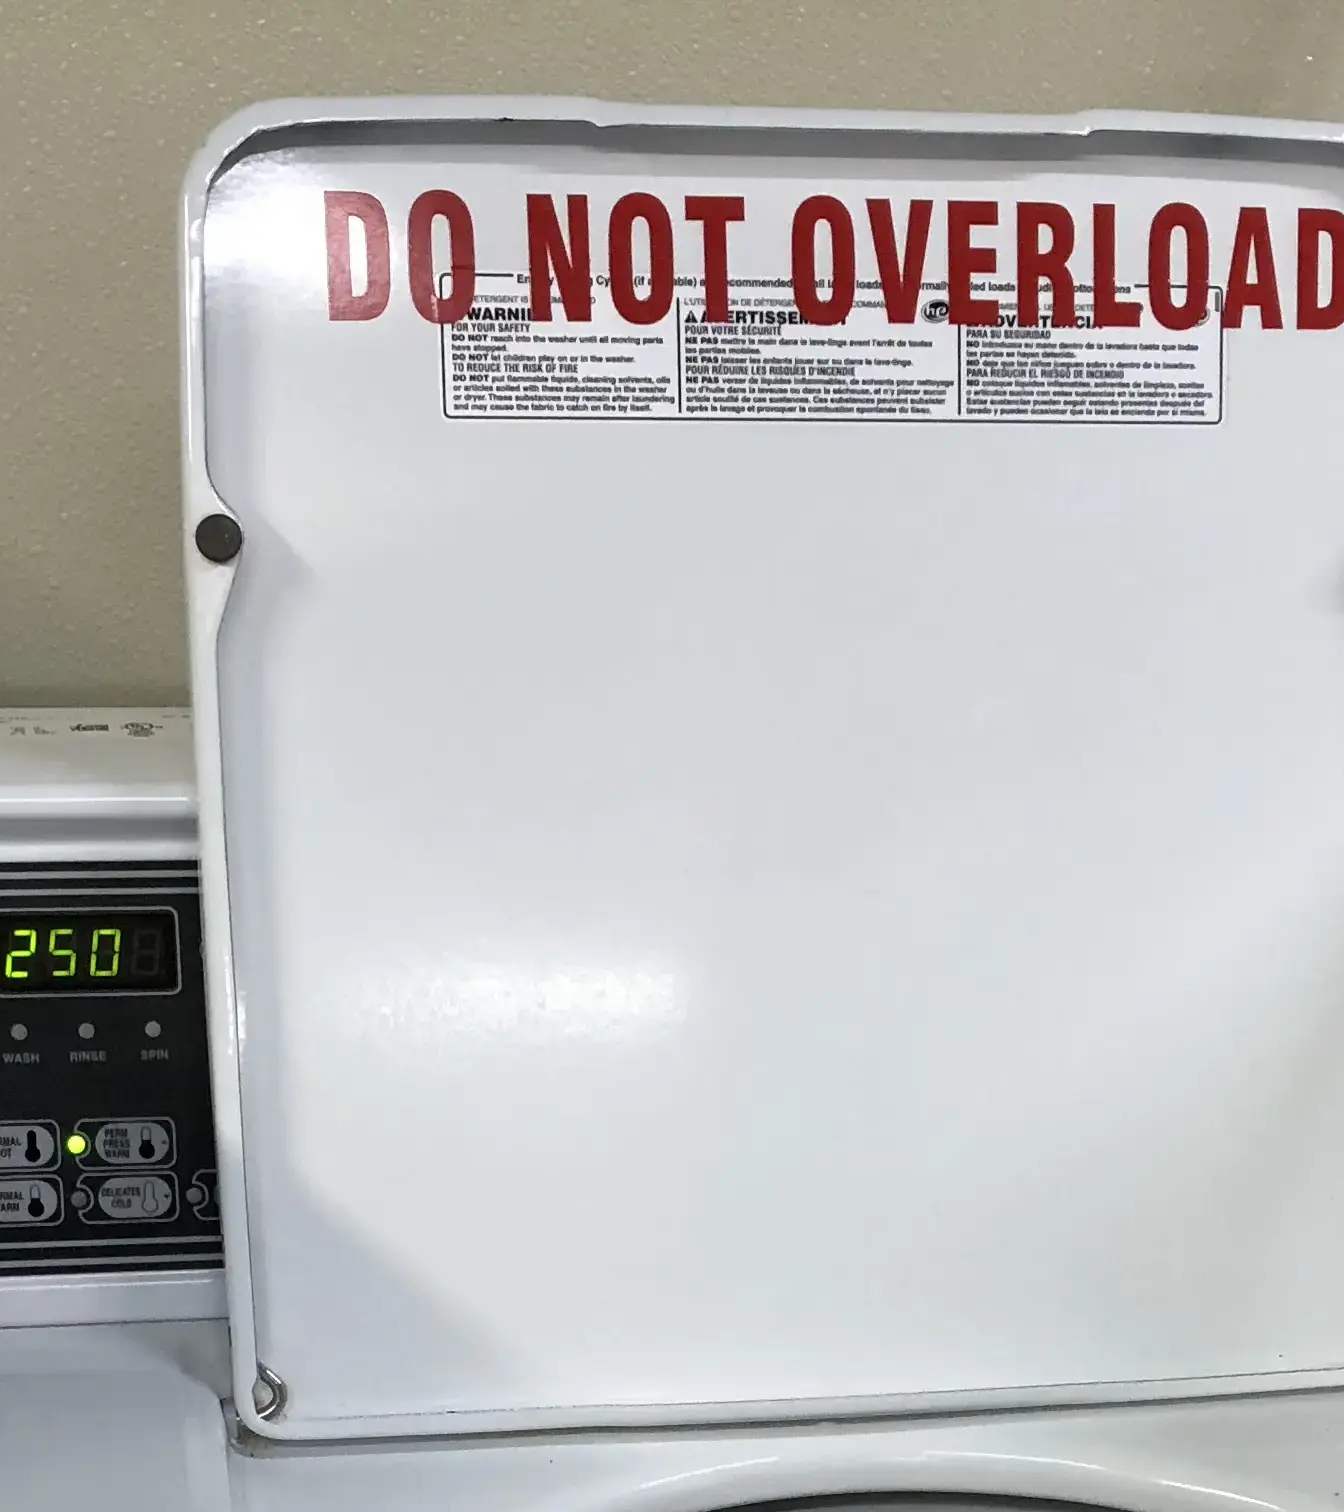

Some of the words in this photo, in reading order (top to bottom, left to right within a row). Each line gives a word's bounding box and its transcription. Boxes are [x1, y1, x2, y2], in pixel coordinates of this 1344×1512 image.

[324, 190, 476, 324] DO
[526, 192, 745, 325] NOT
[471, 323, 496, 333] YOUR
[498, 323, 531, 333] SAFETY
[468, 334, 488, 342] NOT
[452, 353, 466, 361] DO
[468, 353, 489, 361] NOT
[469, 374, 490, 382] NOT
[6, 928, 121, 979] 250
[2, 1052, 40, 1065] WASH
[69, 1050, 107, 1064] RINSE
[140, 1048, 169, 1061] SPIN
[104, 1128, 128, 1139] PERM
[103, 1138, 131, 1149] PRESS
[101, 1186, 141, 1198] DELICATES
